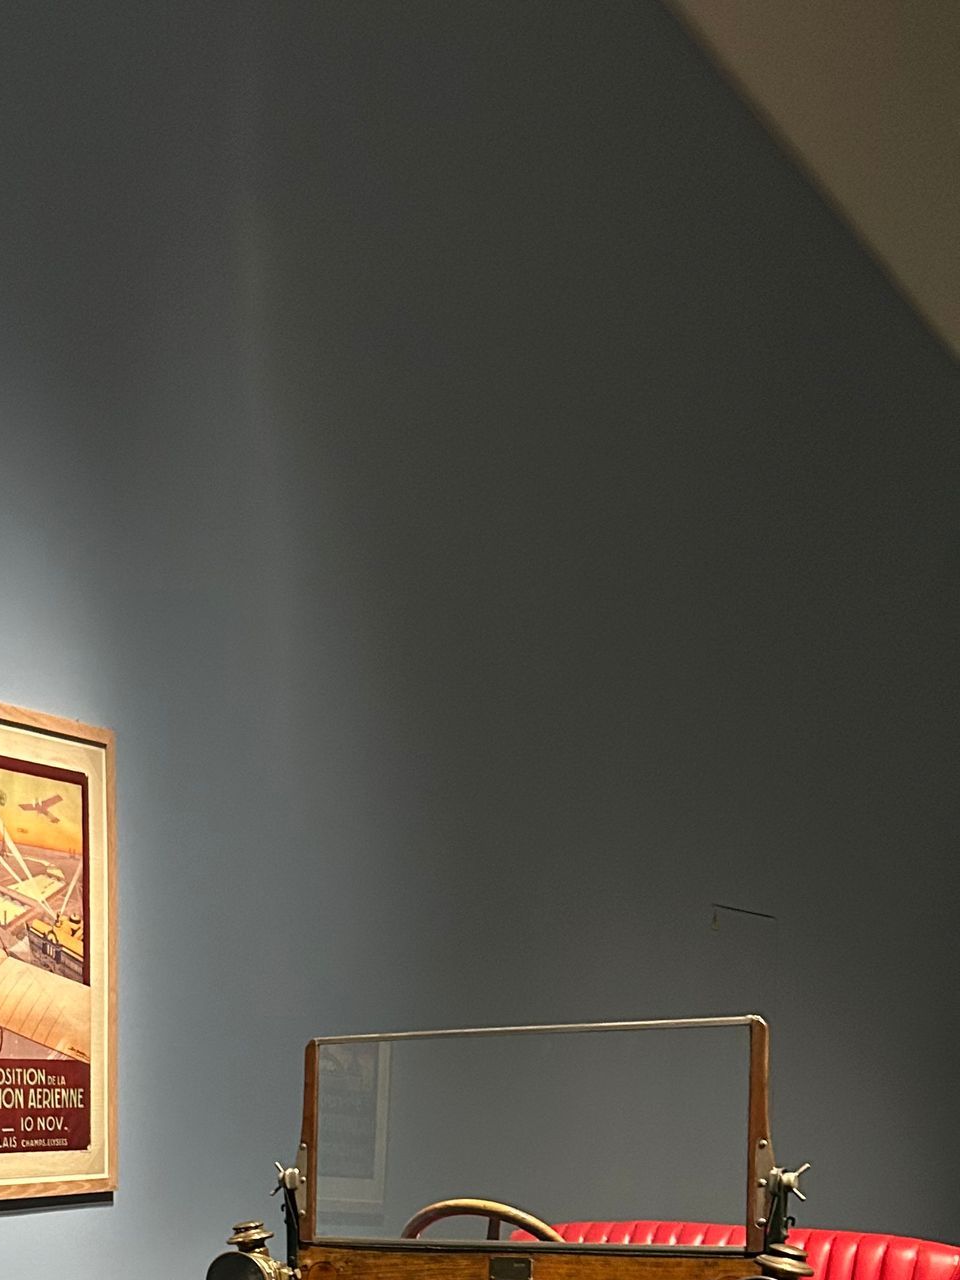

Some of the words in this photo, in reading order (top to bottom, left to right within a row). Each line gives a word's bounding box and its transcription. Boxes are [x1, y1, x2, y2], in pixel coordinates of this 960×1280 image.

[47, 1076, 56, 1086] DE
[56, 1076, 66, 1086] LA
[20, 1115, 32, 1132] 10
[37, 1115, 69, 1132] NOV.
